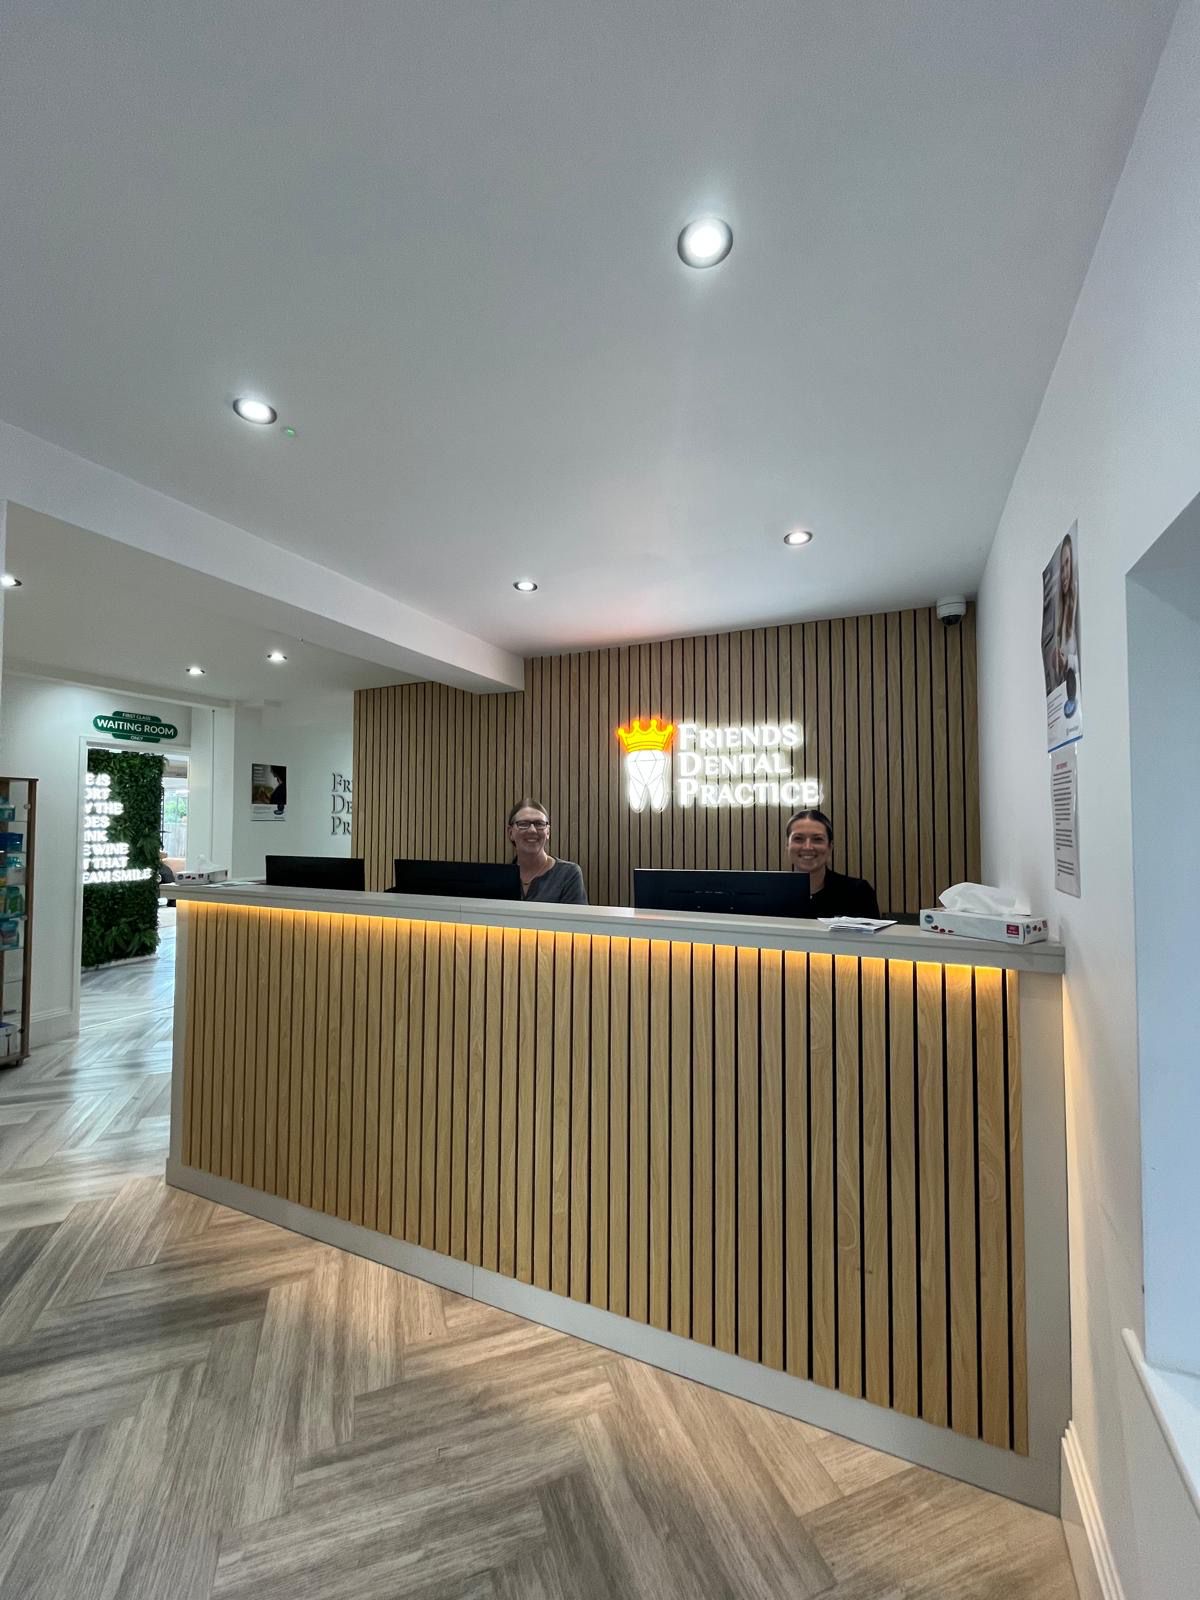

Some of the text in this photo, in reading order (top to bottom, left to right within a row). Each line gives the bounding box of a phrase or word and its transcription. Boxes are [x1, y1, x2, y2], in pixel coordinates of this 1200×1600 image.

[96, 719, 174, 737] WAITING ROOM
[678, 723, 800, 750] FRIENDS
[678, 752, 792, 777] DENTAL
[678, 778, 820, 805] PRACTICE
[94, 802, 122, 814] THE
[92, 843, 129, 855] WINE
[92, 856, 129, 869] THAT
[112, 868, 151, 882] SMILE
